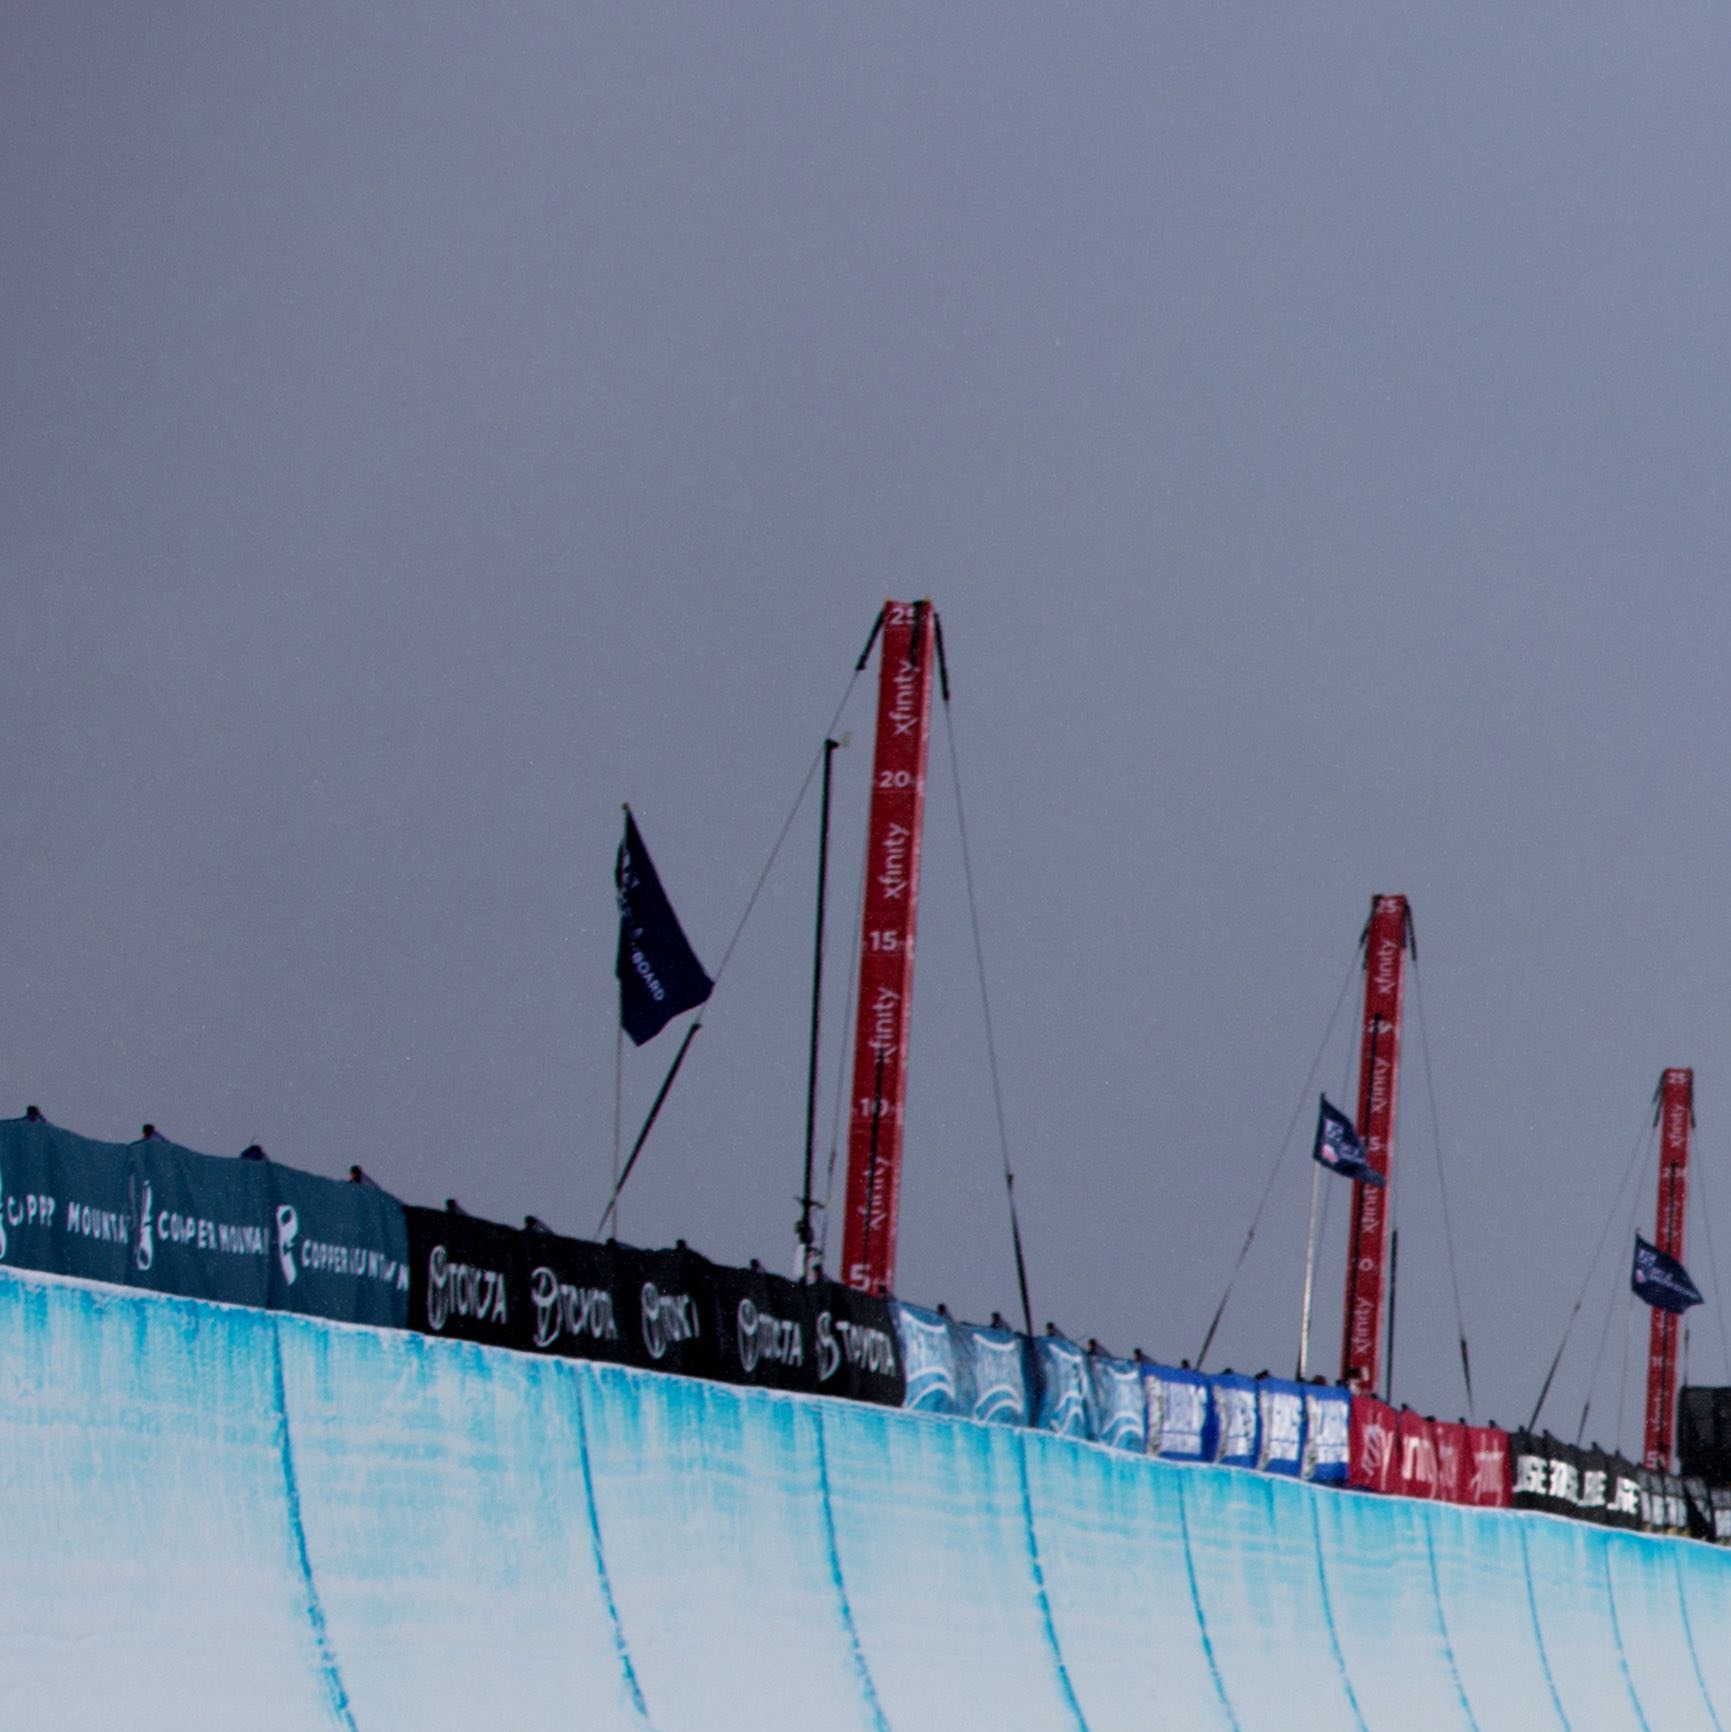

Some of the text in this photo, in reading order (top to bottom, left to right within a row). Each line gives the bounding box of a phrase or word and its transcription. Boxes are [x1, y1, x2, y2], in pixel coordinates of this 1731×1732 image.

[888, 660, 920, 736] xfinity
[879, 770, 911, 788] 20
[875, 823, 910, 899] xfinity
[870, 931, 898, 950] 15
[868, 986, 900, 1064] xfinity
[860, 1099, 888, 1118] 10
[850, 1264, 871, 1291] 5
